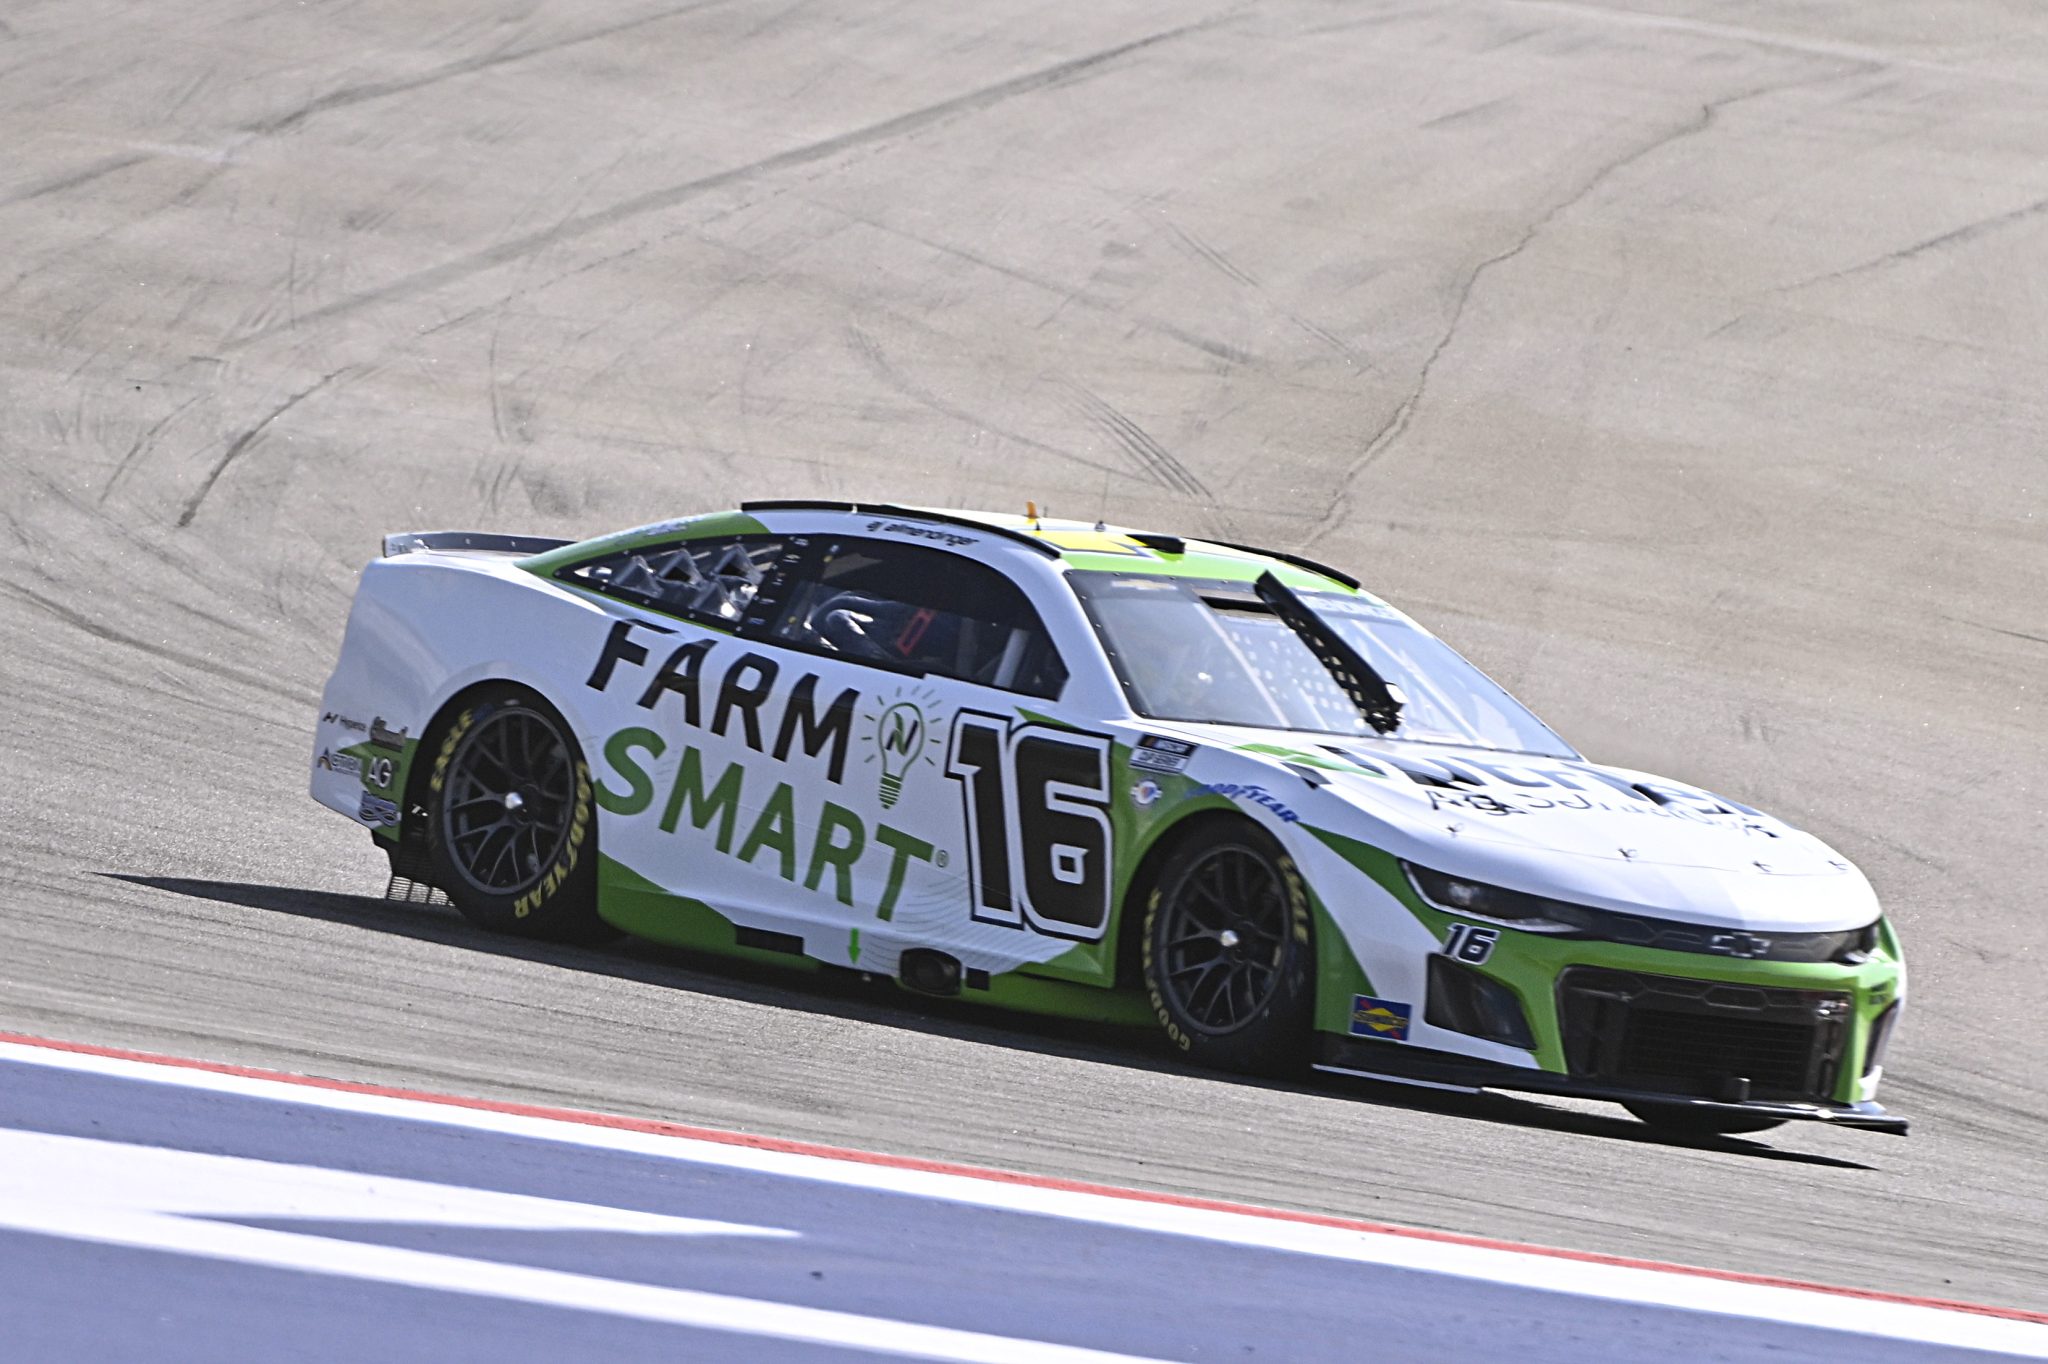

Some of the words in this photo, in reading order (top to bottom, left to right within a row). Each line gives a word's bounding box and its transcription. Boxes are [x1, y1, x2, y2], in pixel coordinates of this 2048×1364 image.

[586, 618, 861, 786] FARM
[513, 760, 592, 918] GOODYEAR
[944, 706, 1115, 945] 16
[1441, 922, 1502, 966] 16
